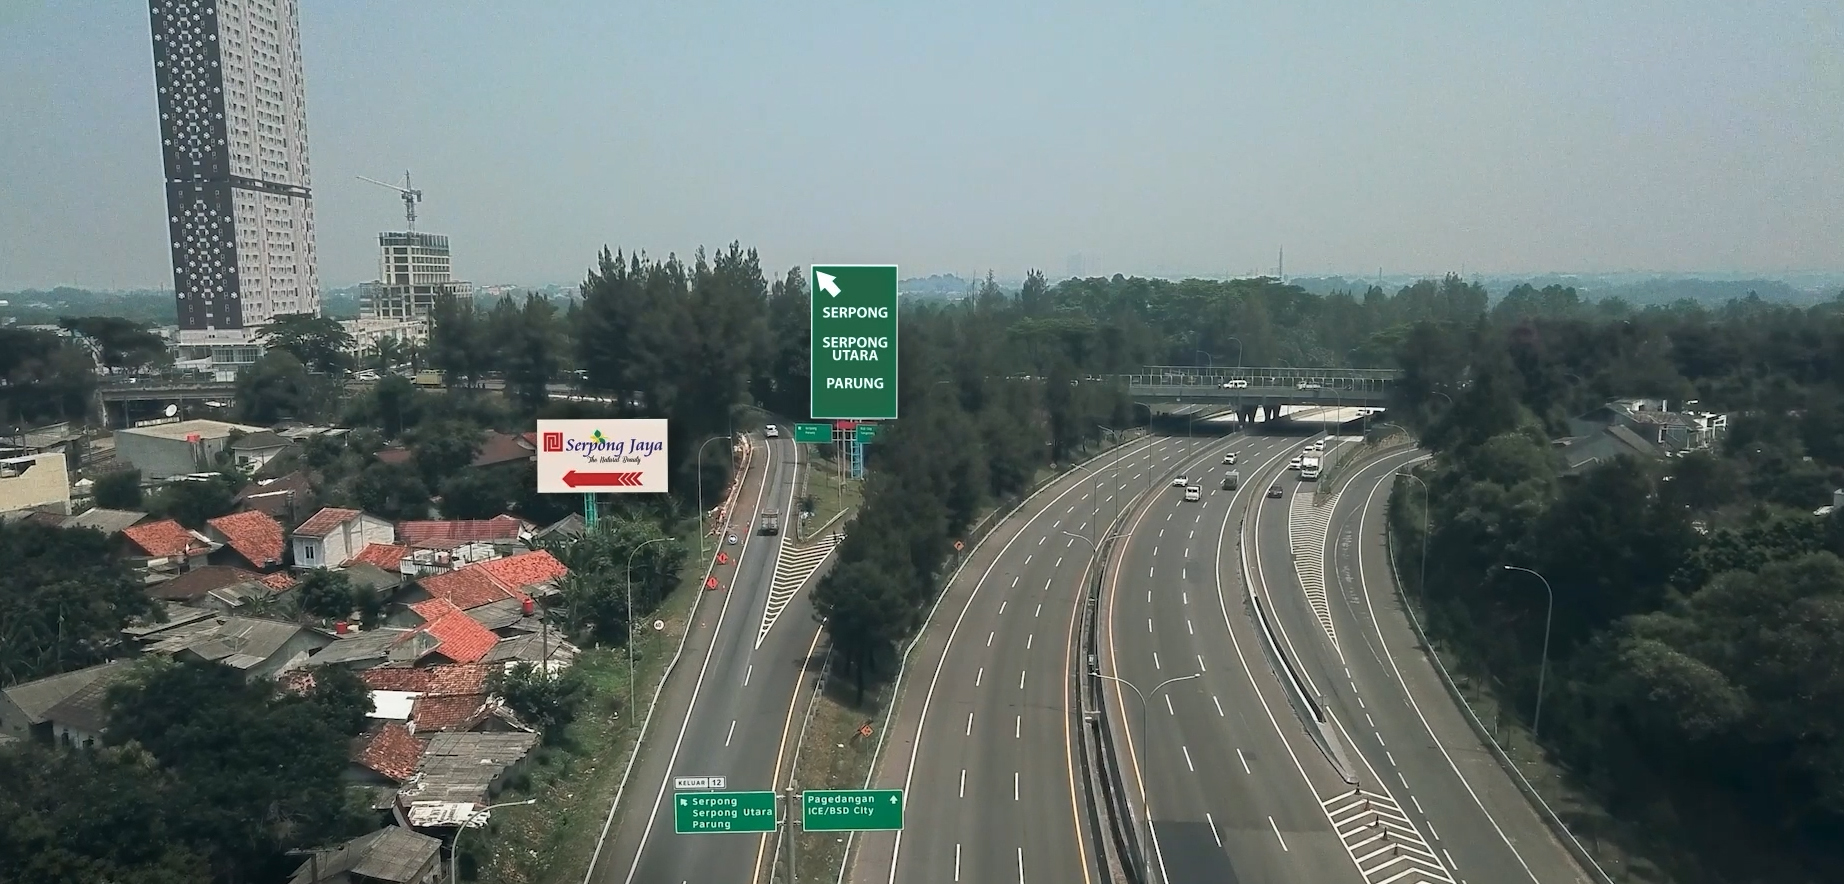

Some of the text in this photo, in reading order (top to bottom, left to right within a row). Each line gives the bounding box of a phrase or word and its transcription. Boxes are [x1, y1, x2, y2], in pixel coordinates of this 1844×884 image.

[822, 306, 889, 319] SERPONG
[822, 336, 889, 349] SERPONG
[832, 349, 879, 361] UTARA
[826, 377, 884, 389] PARUNG
[565, 438, 663, 458] Serpong Jaya
[587, 455, 598, 464] The
[599, 455, 620, 464] Natural
[692, 798, 738, 807] Serpong
[807, 795, 875, 806] Pagedangan
[692, 808, 773, 818] Serpong Utara
[808, 807, 850, 816] ICE/BSD
[692, 820, 731, 830] Parung
